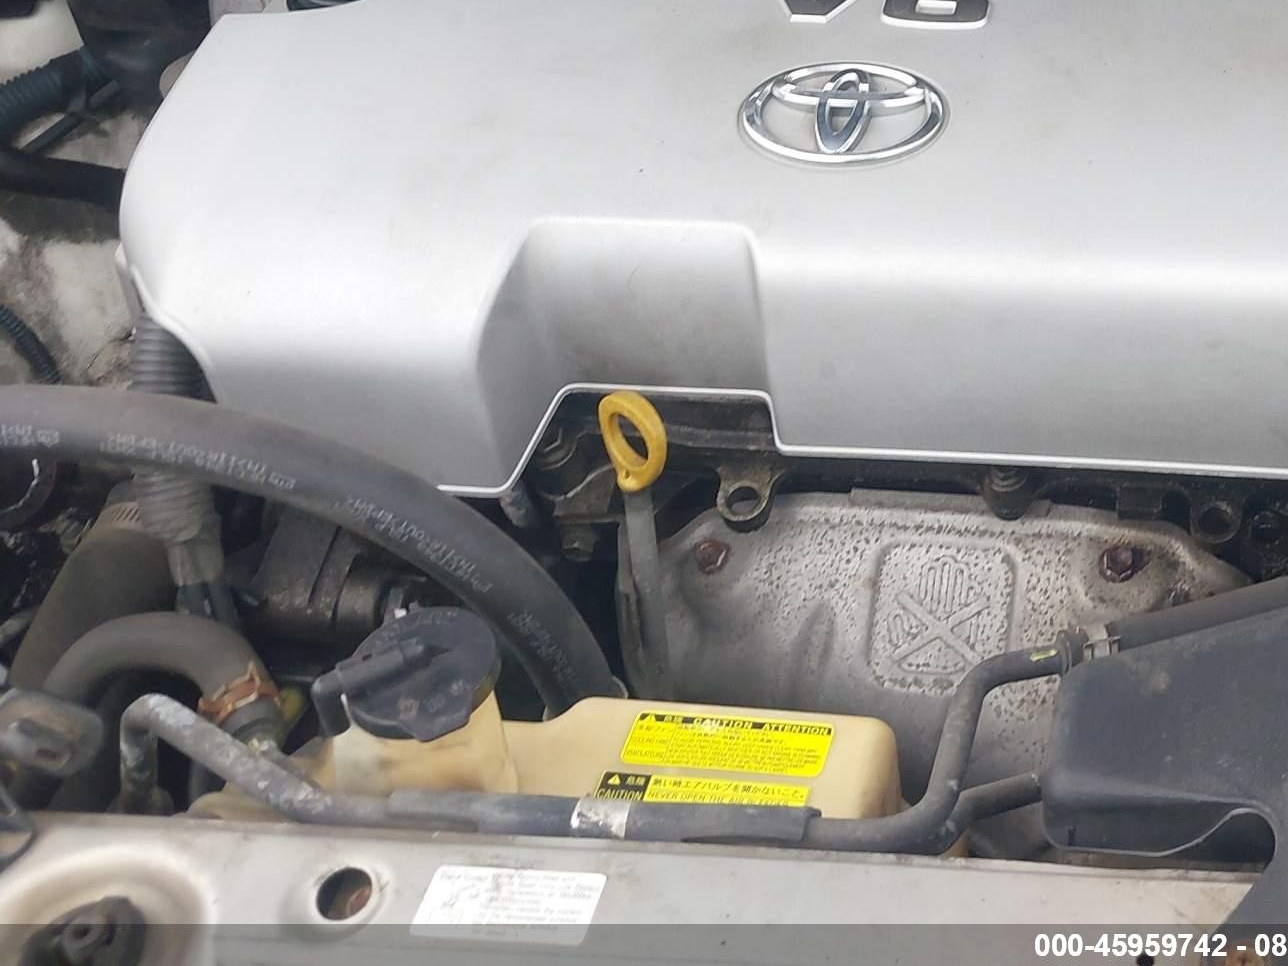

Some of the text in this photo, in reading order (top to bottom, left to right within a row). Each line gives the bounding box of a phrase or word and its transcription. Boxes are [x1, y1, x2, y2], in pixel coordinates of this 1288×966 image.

[693, 716, 753, 730] CAUTION
[763, 722, 830, 736] ATTENTION
[596, 788, 643, 802] CAUTION
